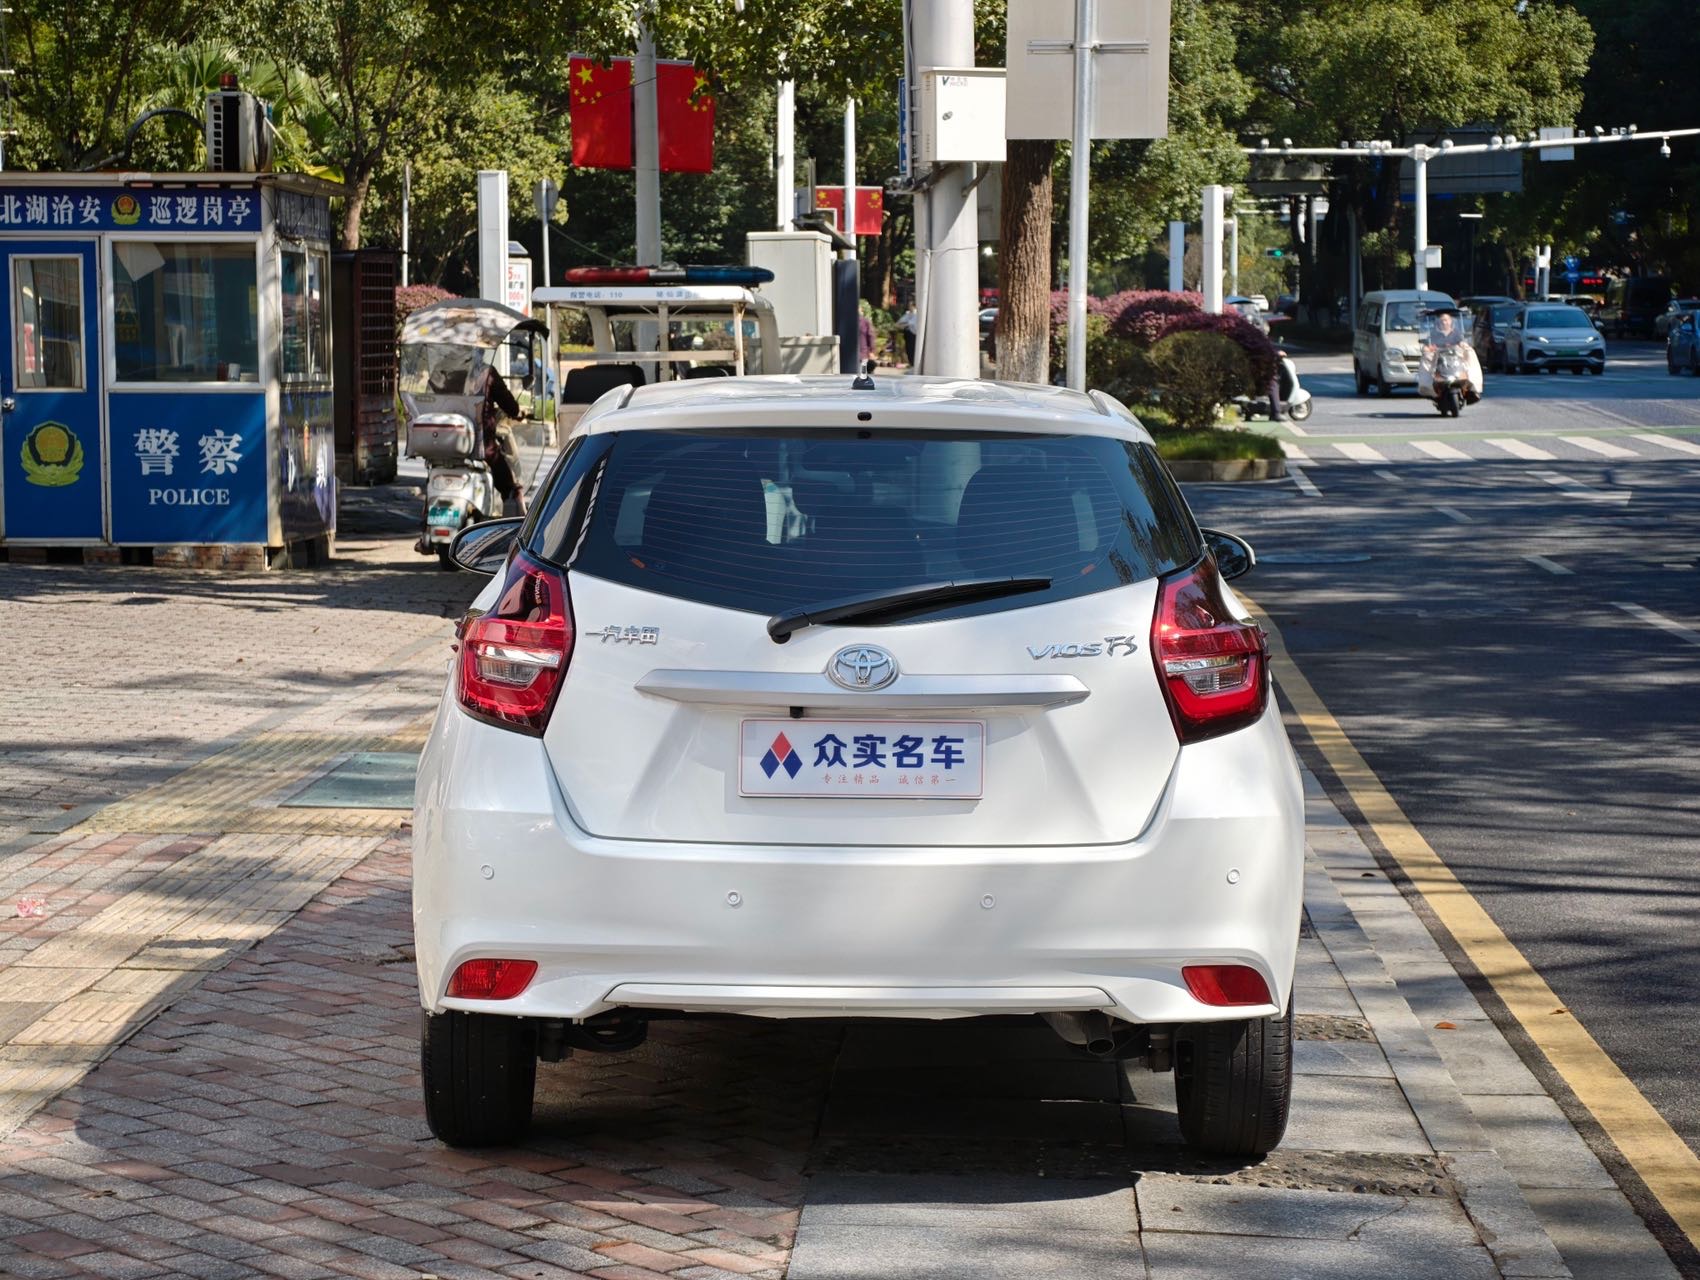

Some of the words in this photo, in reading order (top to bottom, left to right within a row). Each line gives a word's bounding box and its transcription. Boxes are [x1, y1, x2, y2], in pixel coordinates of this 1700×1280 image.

[0, 195, 101, 225] 北湖治安
[149, 195, 251, 226] 巡逻岗亭
[133, 428, 243, 476] 警察
[148, 488, 230, 506] POLICE
[585, 625, 660, 645] 一汽丰田
[1026, 642, 1103, 660] VIOS
[813, 733, 965, 769] 众实名车
[821, 773, 881, 785] 专注精品
[898, 774, 957, 786] 诚信第一
